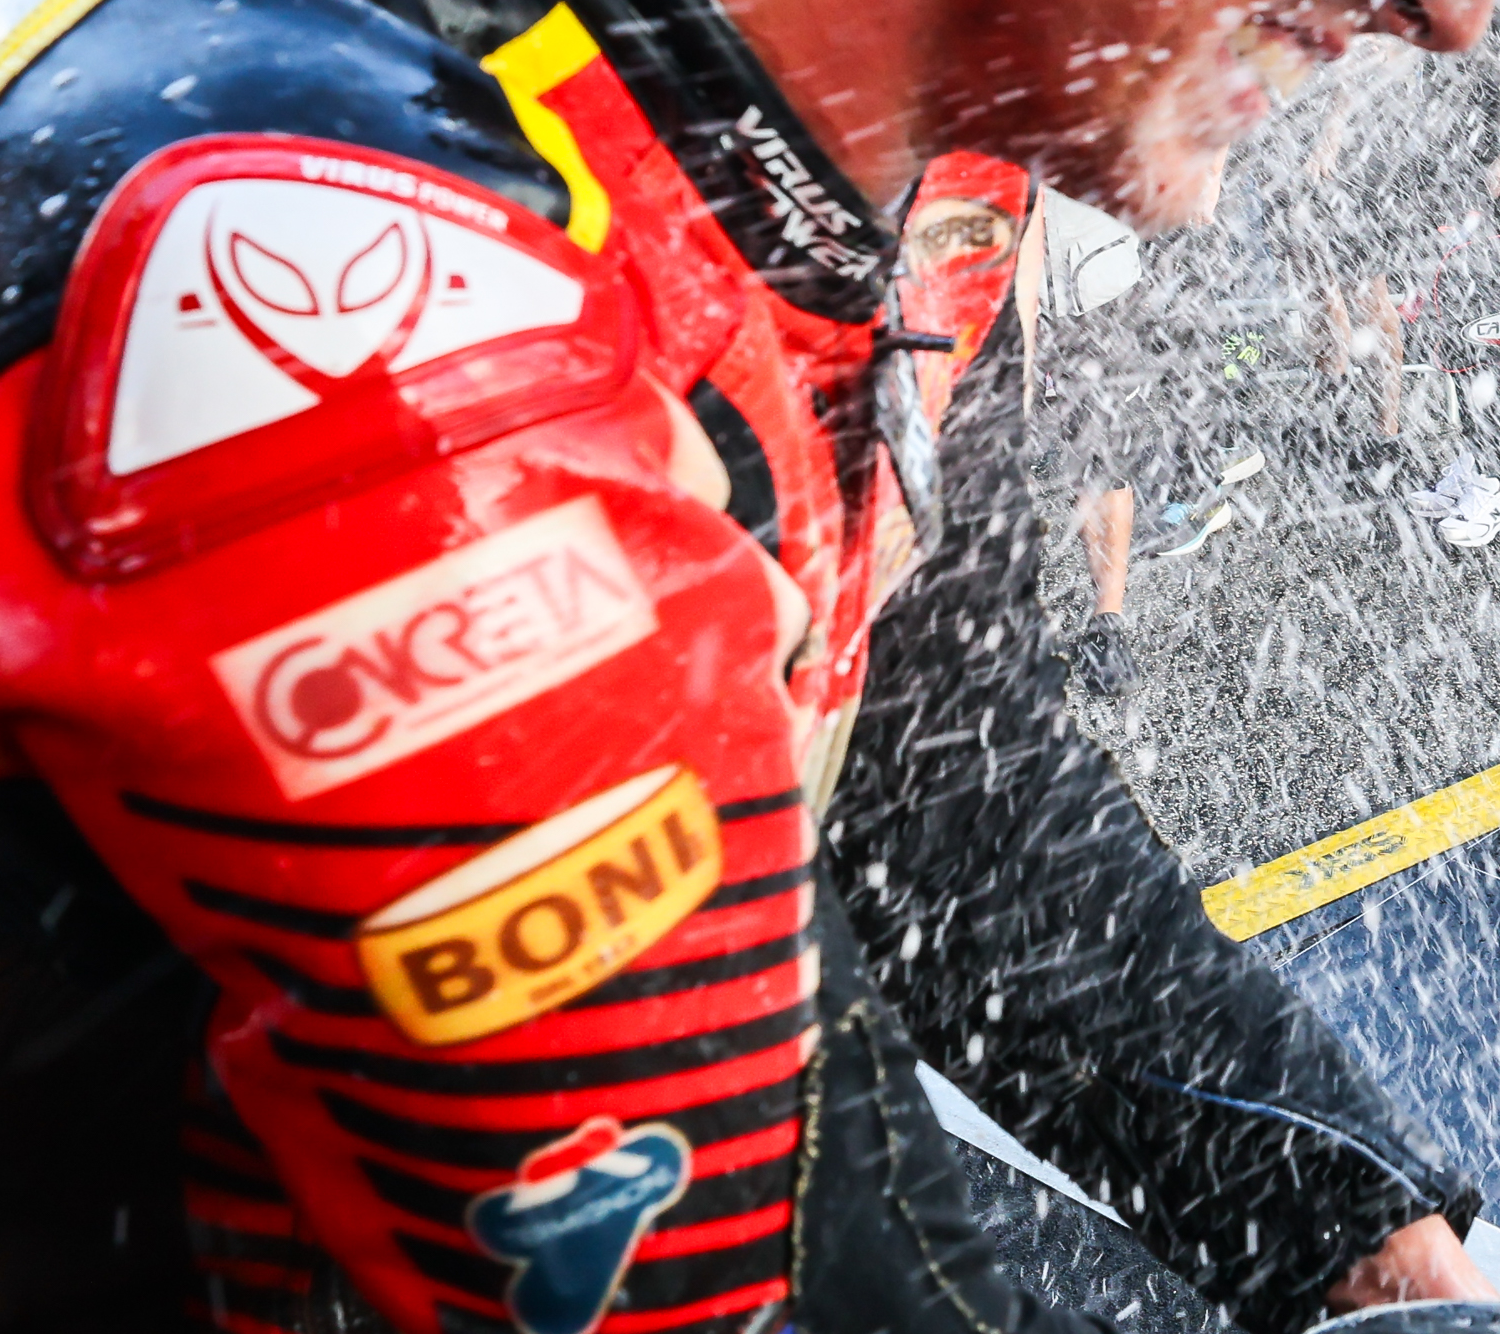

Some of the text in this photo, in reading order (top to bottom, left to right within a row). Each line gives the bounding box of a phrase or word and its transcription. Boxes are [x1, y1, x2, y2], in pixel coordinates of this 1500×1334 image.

[300, 154, 510, 233] VIRUS POWER
[738, 104, 862, 236] VIRUS
[397, 809, 698, 1015] BONI
